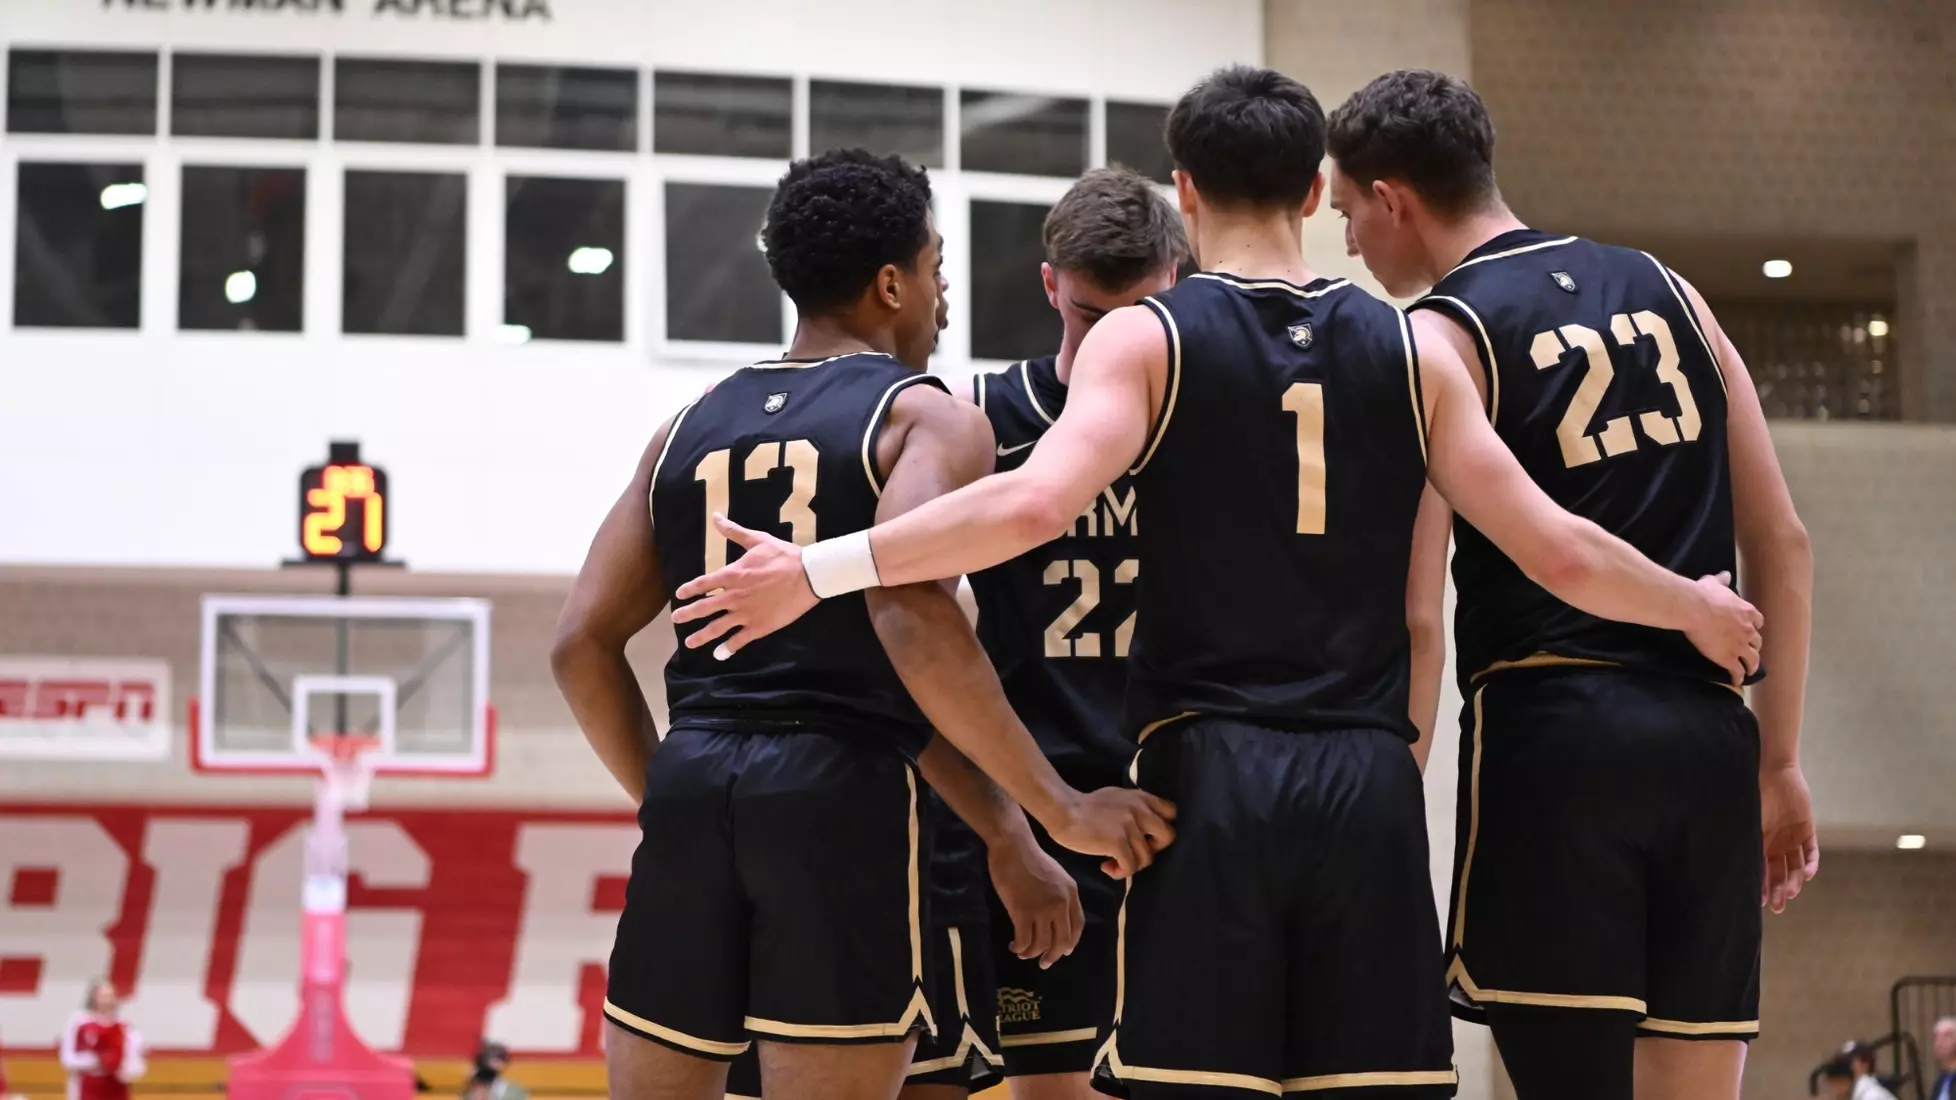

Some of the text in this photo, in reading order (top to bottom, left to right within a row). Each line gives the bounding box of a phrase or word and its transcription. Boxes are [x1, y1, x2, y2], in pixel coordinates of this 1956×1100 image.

[1282, 382, 1326, 535] 1
[1530, 310, 1702, 469] 23
[694, 439, 819, 597] 13
[0, 815, 433, 1051] BIG
